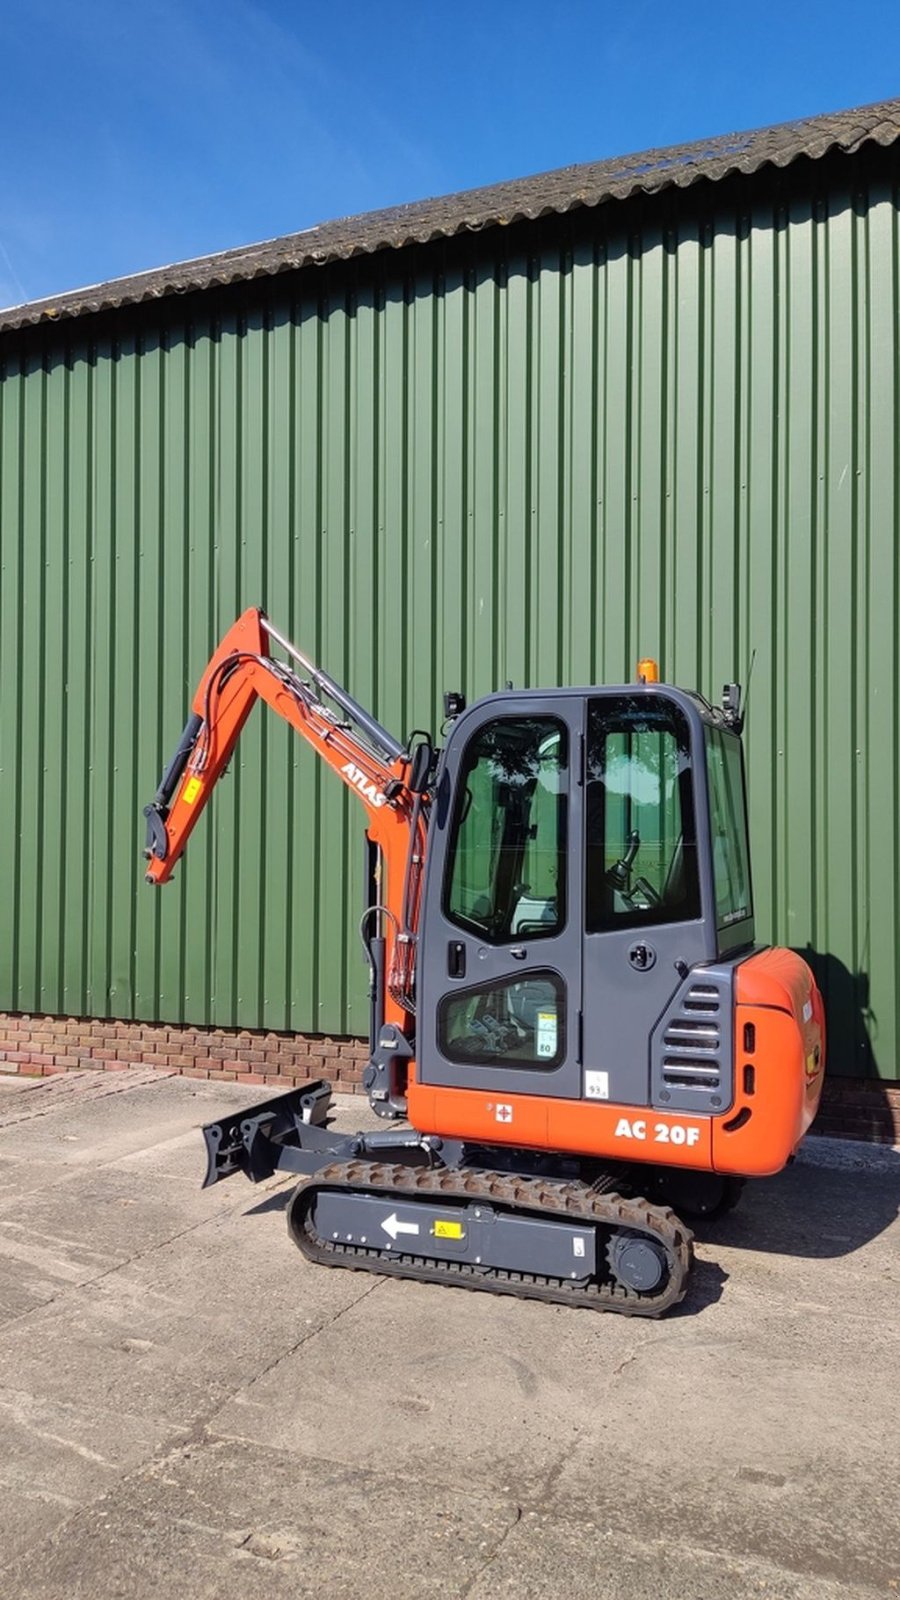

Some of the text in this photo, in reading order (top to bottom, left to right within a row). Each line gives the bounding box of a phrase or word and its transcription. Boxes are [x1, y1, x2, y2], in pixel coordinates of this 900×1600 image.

[341, 762, 387, 807] ATLAS
[589, 1085, 601, 1095] 93
[614, 1118, 700, 1146] AC 20F
